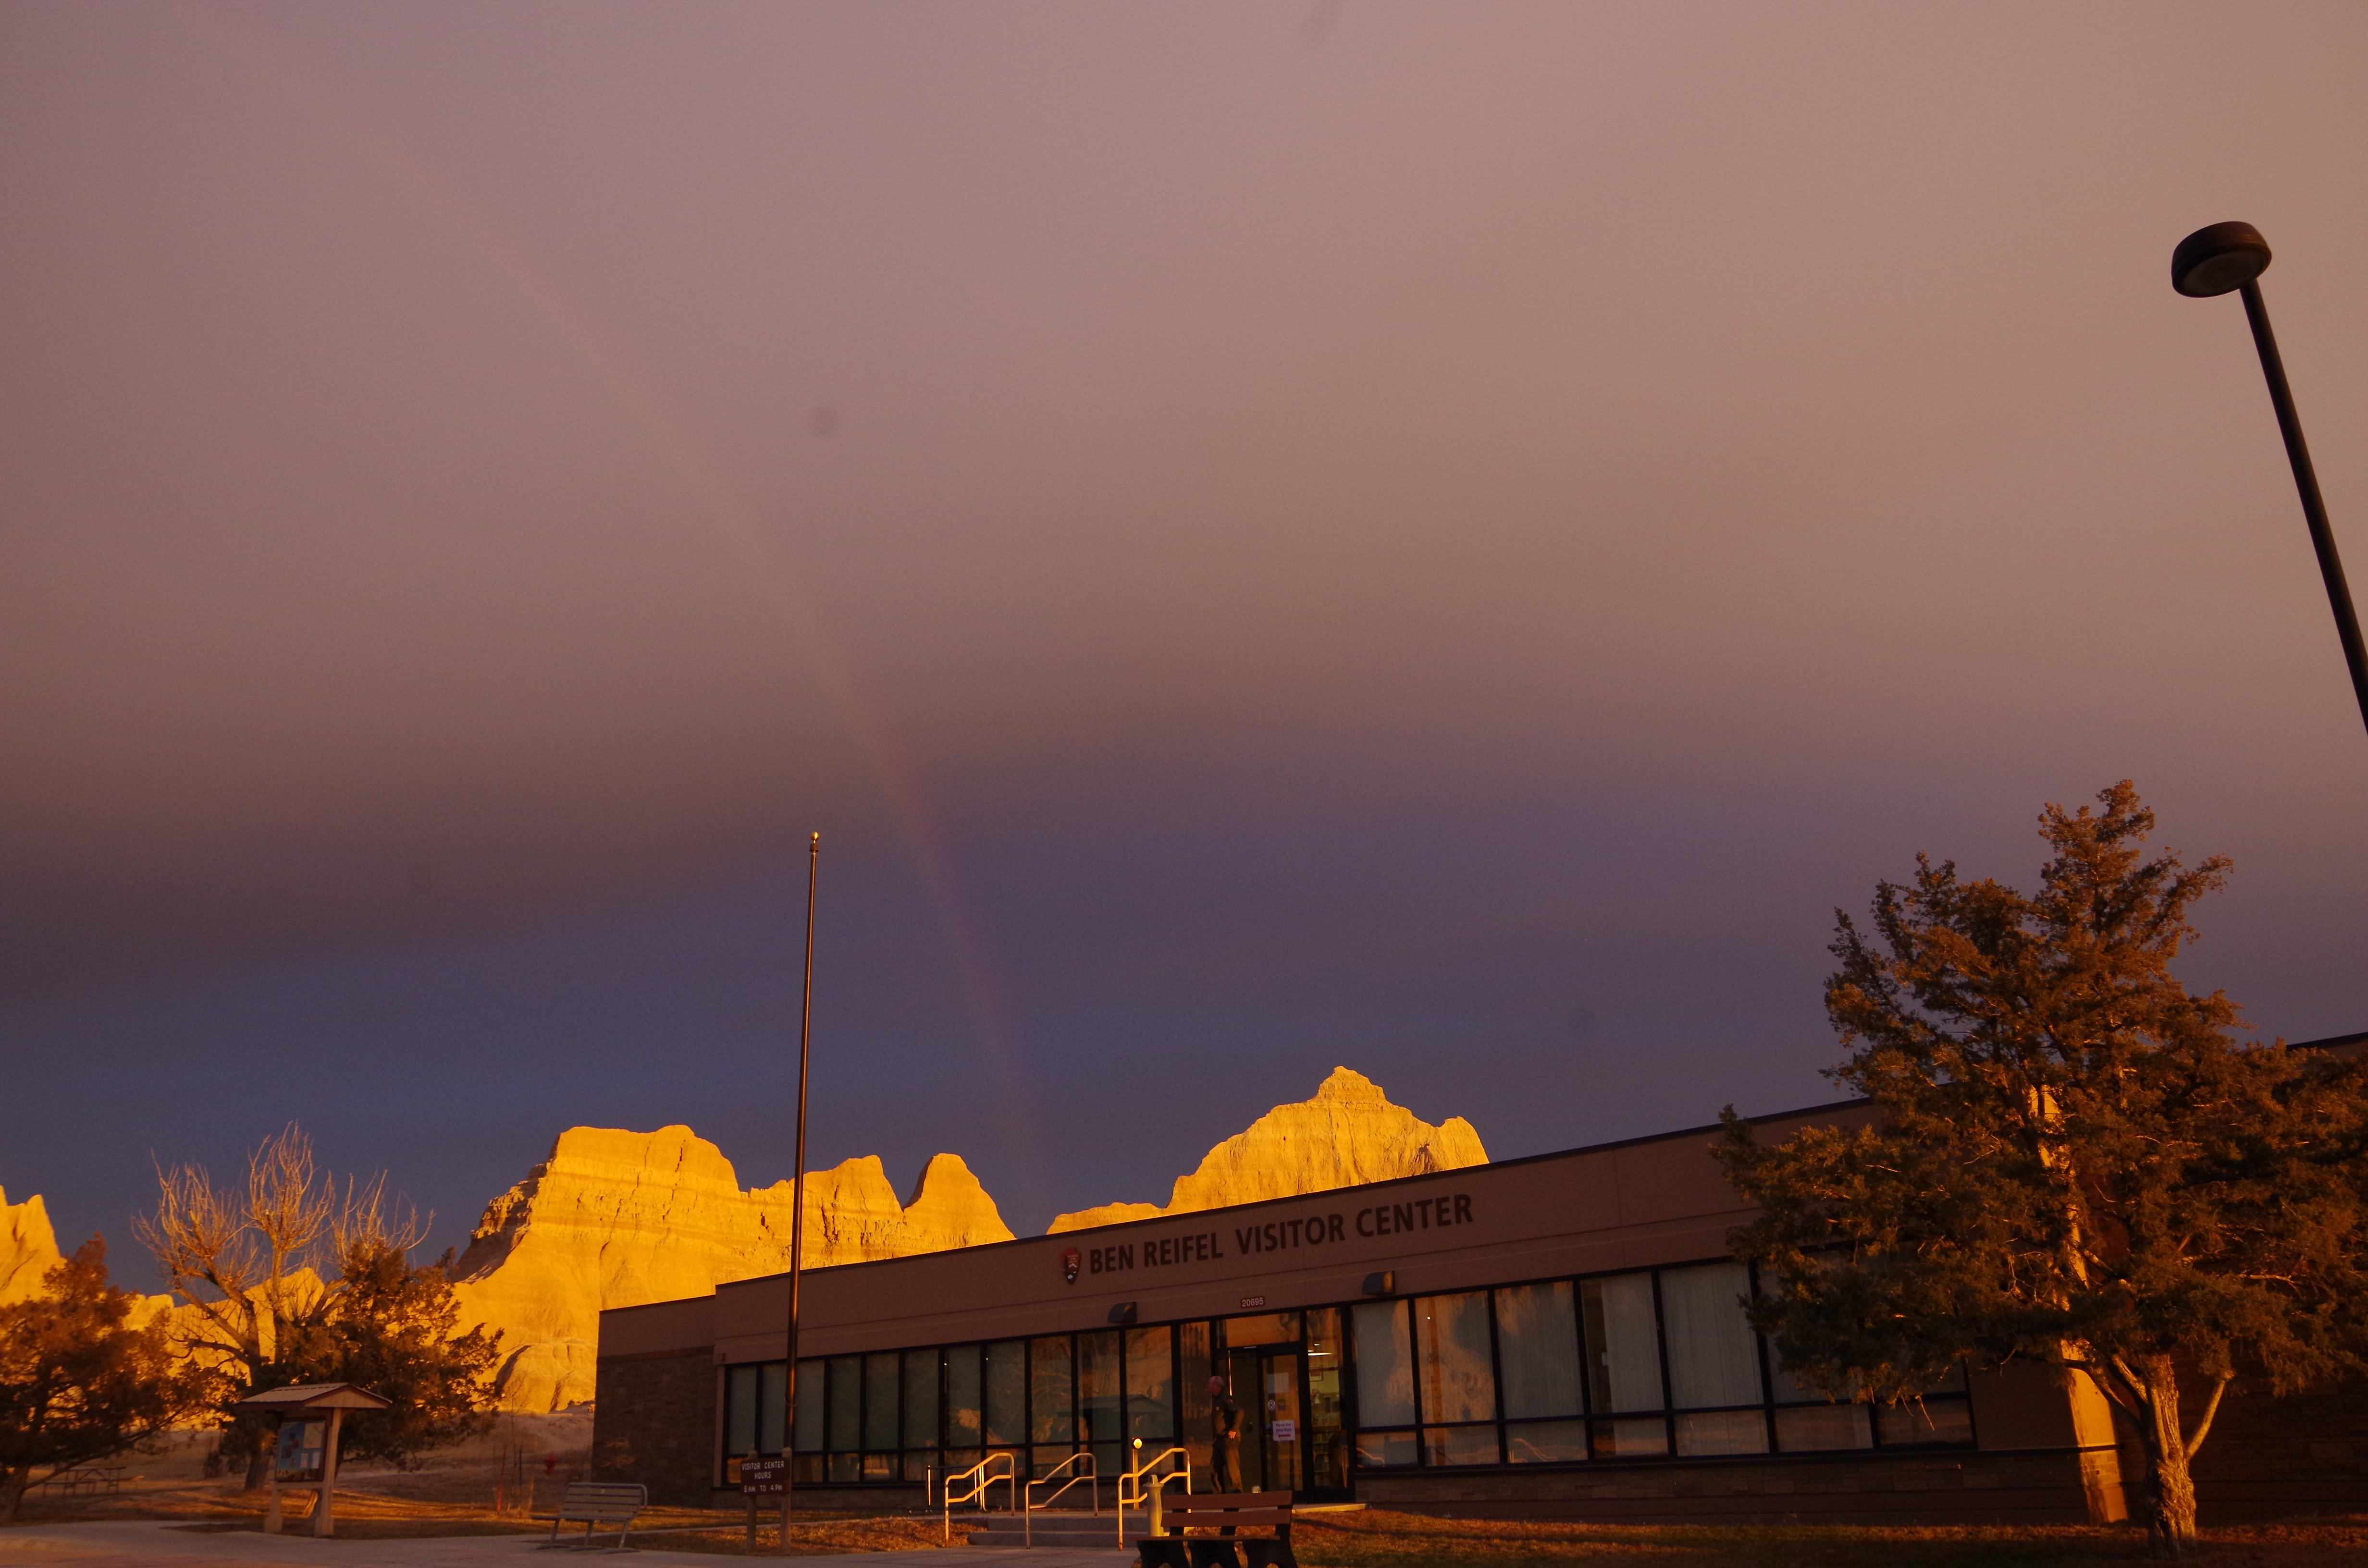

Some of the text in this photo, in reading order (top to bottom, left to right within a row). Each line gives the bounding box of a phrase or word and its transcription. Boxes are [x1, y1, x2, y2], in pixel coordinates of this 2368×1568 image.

[1090, 1194, 1473, 1274] BEN REIFEL VISITOR CENTER
[1242, 1298, 1263, 1307] 20695
[754, 1471, 771, 1480] HOURS
